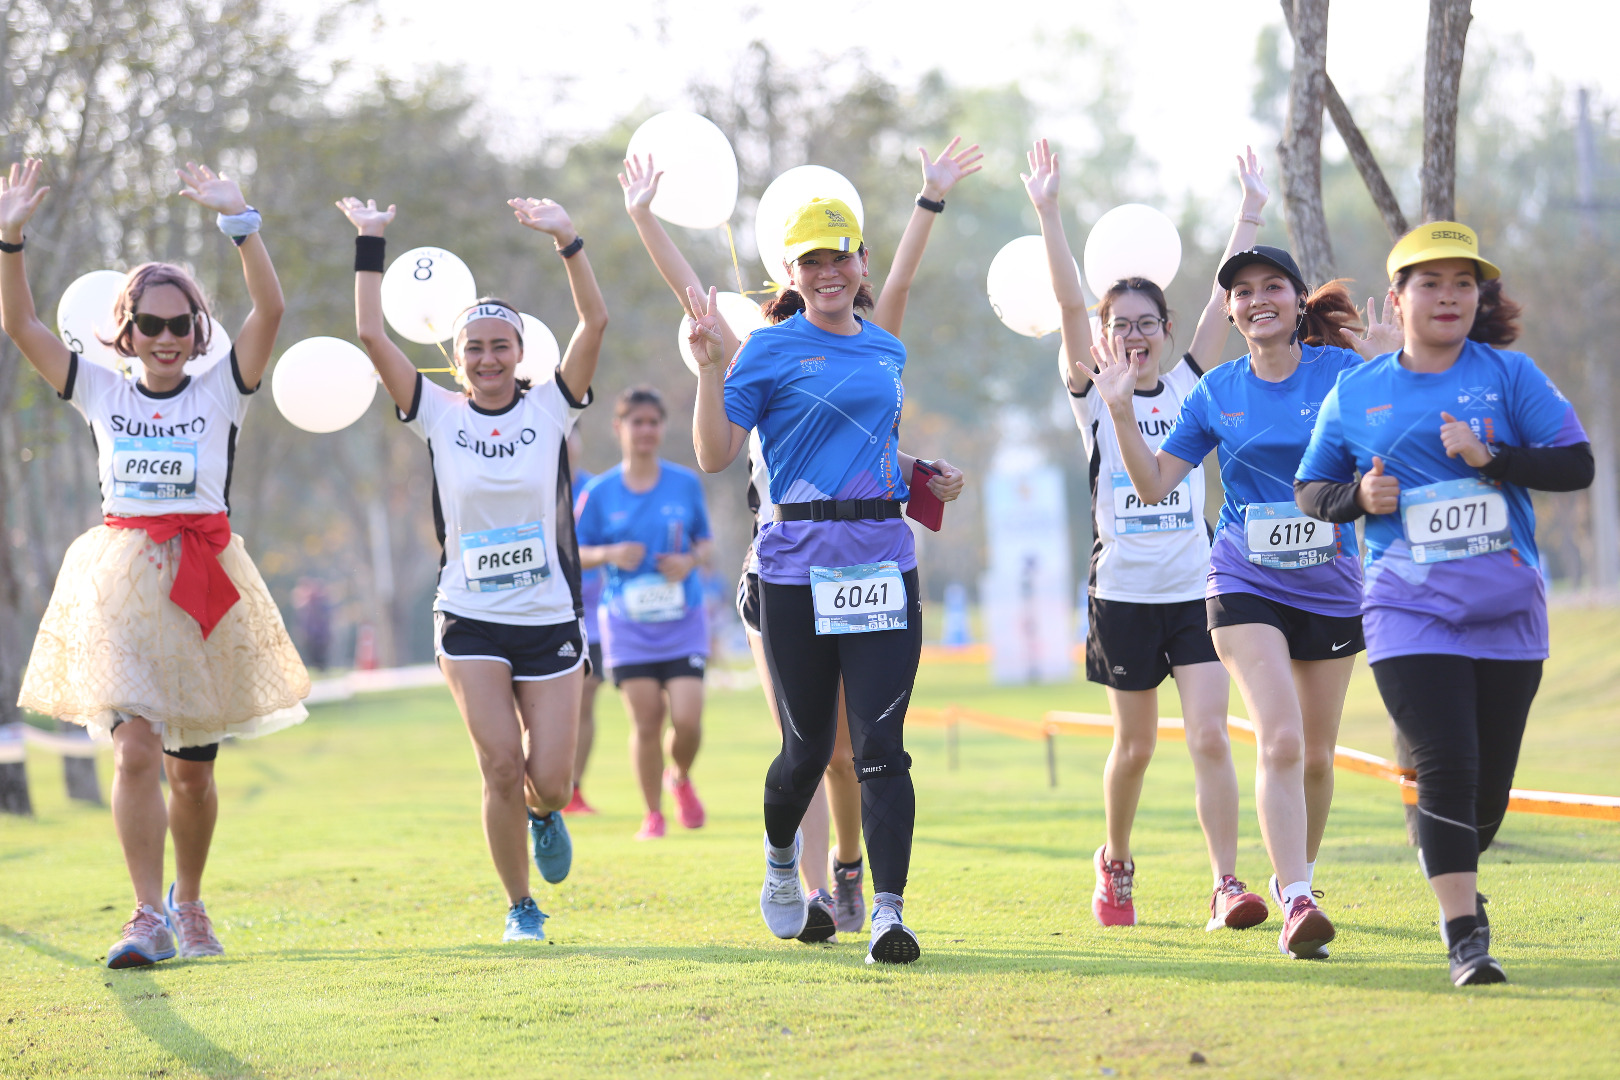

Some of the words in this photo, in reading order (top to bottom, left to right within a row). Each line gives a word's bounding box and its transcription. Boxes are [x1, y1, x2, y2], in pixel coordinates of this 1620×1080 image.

[1431, 230, 1473, 245] SEIKO
[414, 257, 433, 281] 8
[467, 306, 507, 321] FILA
[1485, 393, 1498, 402] XC
[1300, 408, 1311, 416] SP
[110, 414, 206, 438] SUUNTO
[1470, 417, 1482, 441] CRO
[455, 428, 537, 458] SUNO
[125, 458, 183, 476] PACER
[1125, 490, 1180, 509] PER
[1429, 501, 1487, 534] 6071
[1269, 521, 1316, 546] 6119
[478, 547, 533, 571] PACER
[834, 582, 888, 609] 6041
